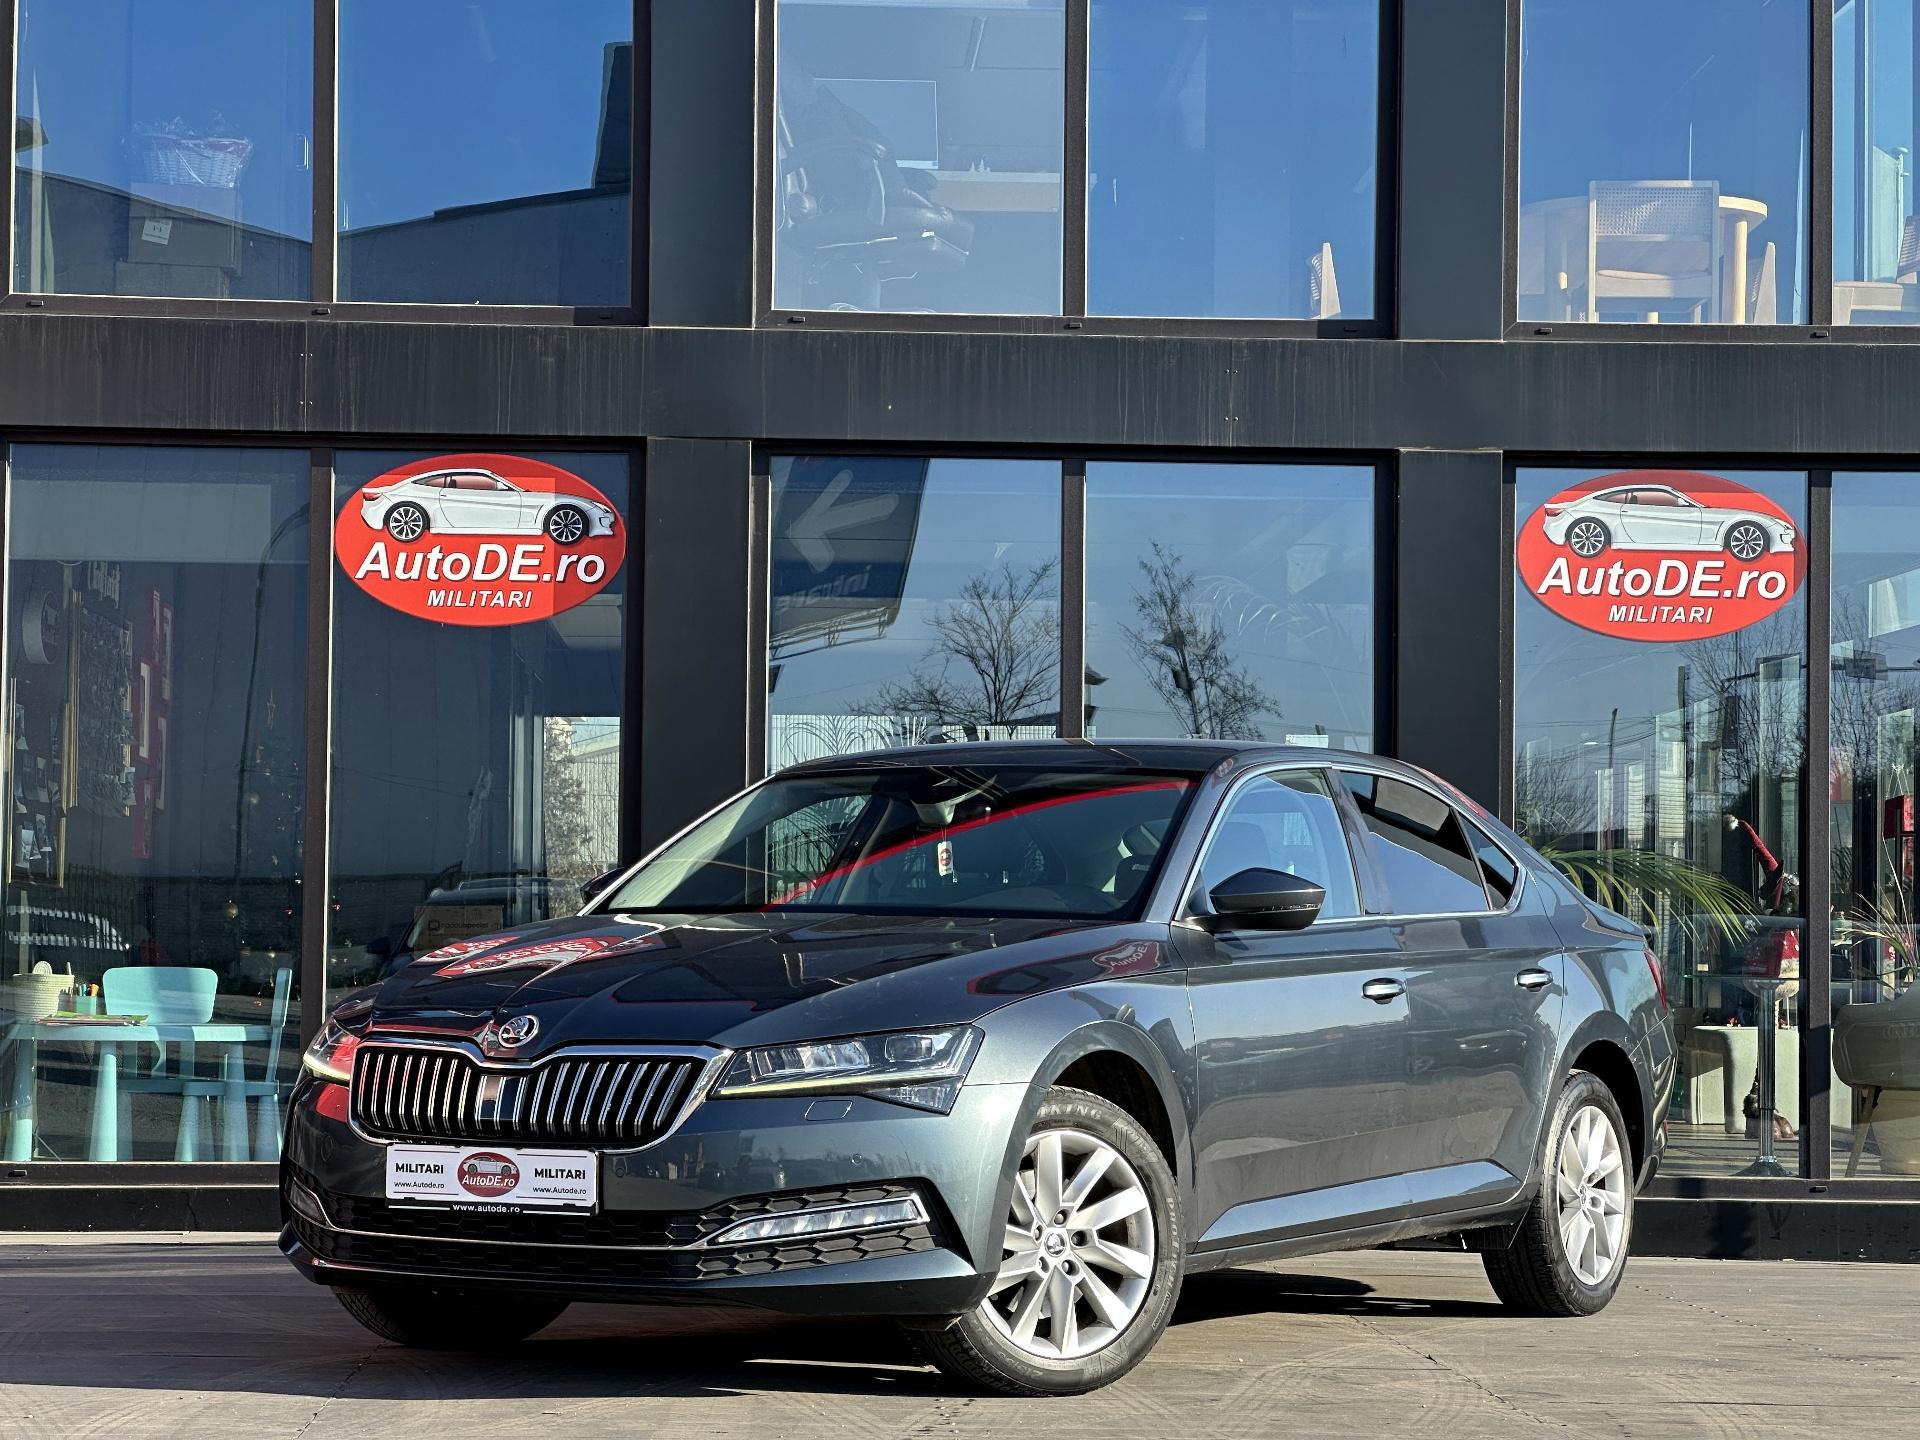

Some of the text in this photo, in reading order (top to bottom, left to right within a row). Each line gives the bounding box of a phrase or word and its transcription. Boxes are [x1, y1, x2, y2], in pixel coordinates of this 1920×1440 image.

[354, 541, 606, 584] AutoDE.ro
[1537, 557, 1787, 600] AutoDE.ro
[427, 589, 533, 608] MILITARI
[1608, 605, 1715, 624] MILITARI
[395, 1162, 444, 1174] MILITARI
[534, 1167, 586, 1180] MILITARI
[393, 1180, 445, 1190] www.Autode.ro
[461, 1174, 516, 1188] AutoDE.ro
[532, 1185, 587, 1196] www.Autode.ro
[452, 1203, 521, 1214] www.autode.ro
